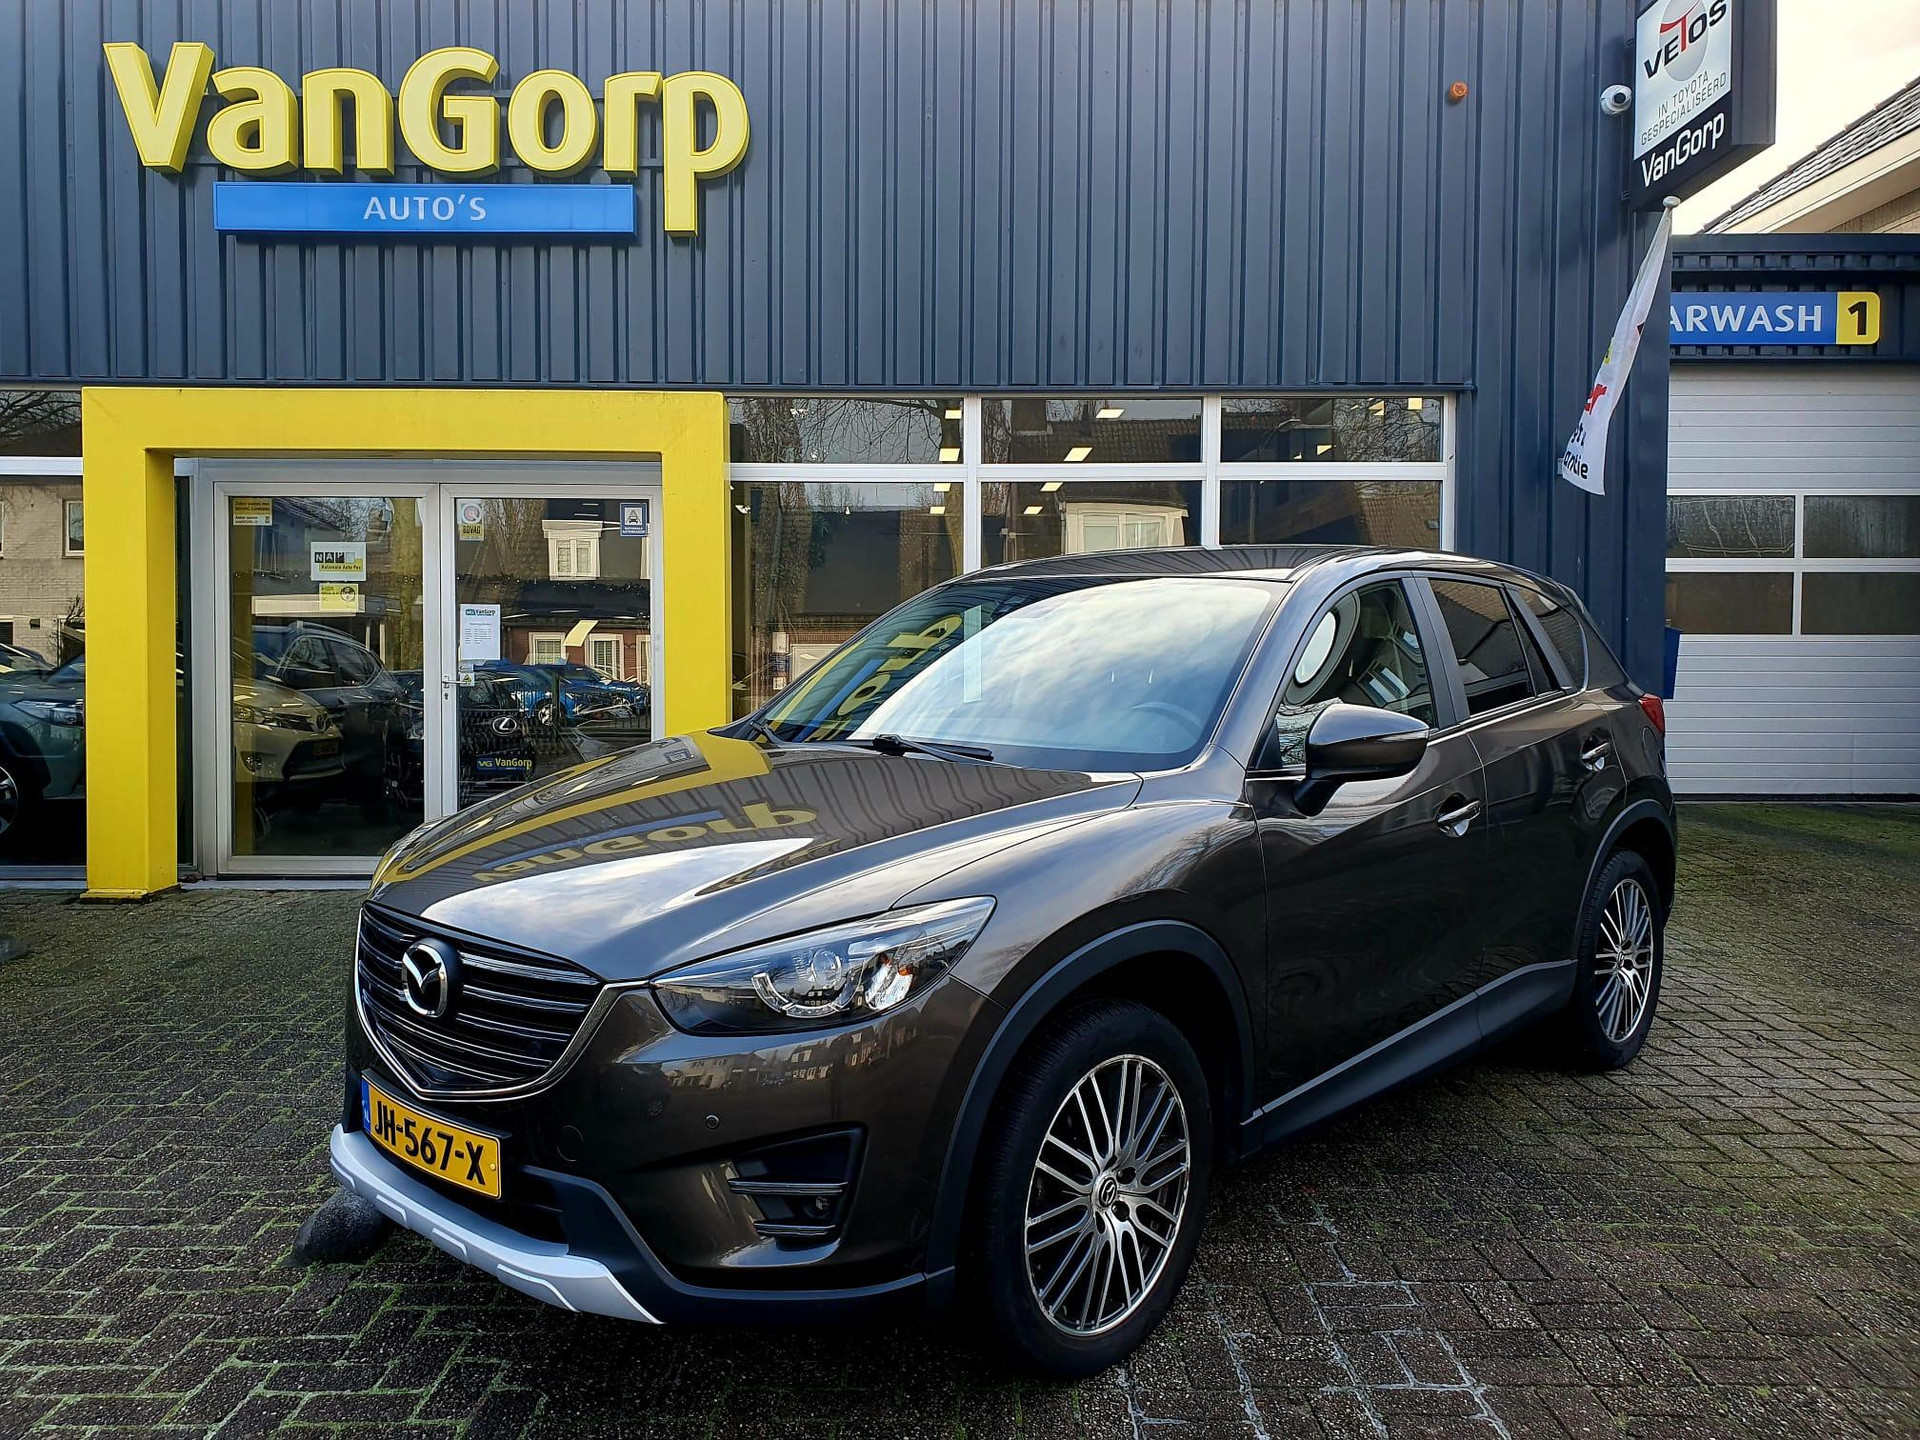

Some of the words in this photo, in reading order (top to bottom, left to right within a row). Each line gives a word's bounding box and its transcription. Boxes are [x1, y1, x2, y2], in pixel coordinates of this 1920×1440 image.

[1643, 0, 1728, 79] VETOS
[1641, 72, 1728, 146] GESPECIALISEERD
[1657, 103, 1669, 119] IN
[1672, 70, 1710, 105] TOYOTA
[103, 42, 751, 238] VanGorp
[1641, 112, 1725, 188] VanGorp
[363, 193, 487, 221] AUTO'S
[1847, 301, 1868, 336] 1
[495, 758, 533, 770] VanGorp
[374, 1100, 487, 1186] JH-567-X
